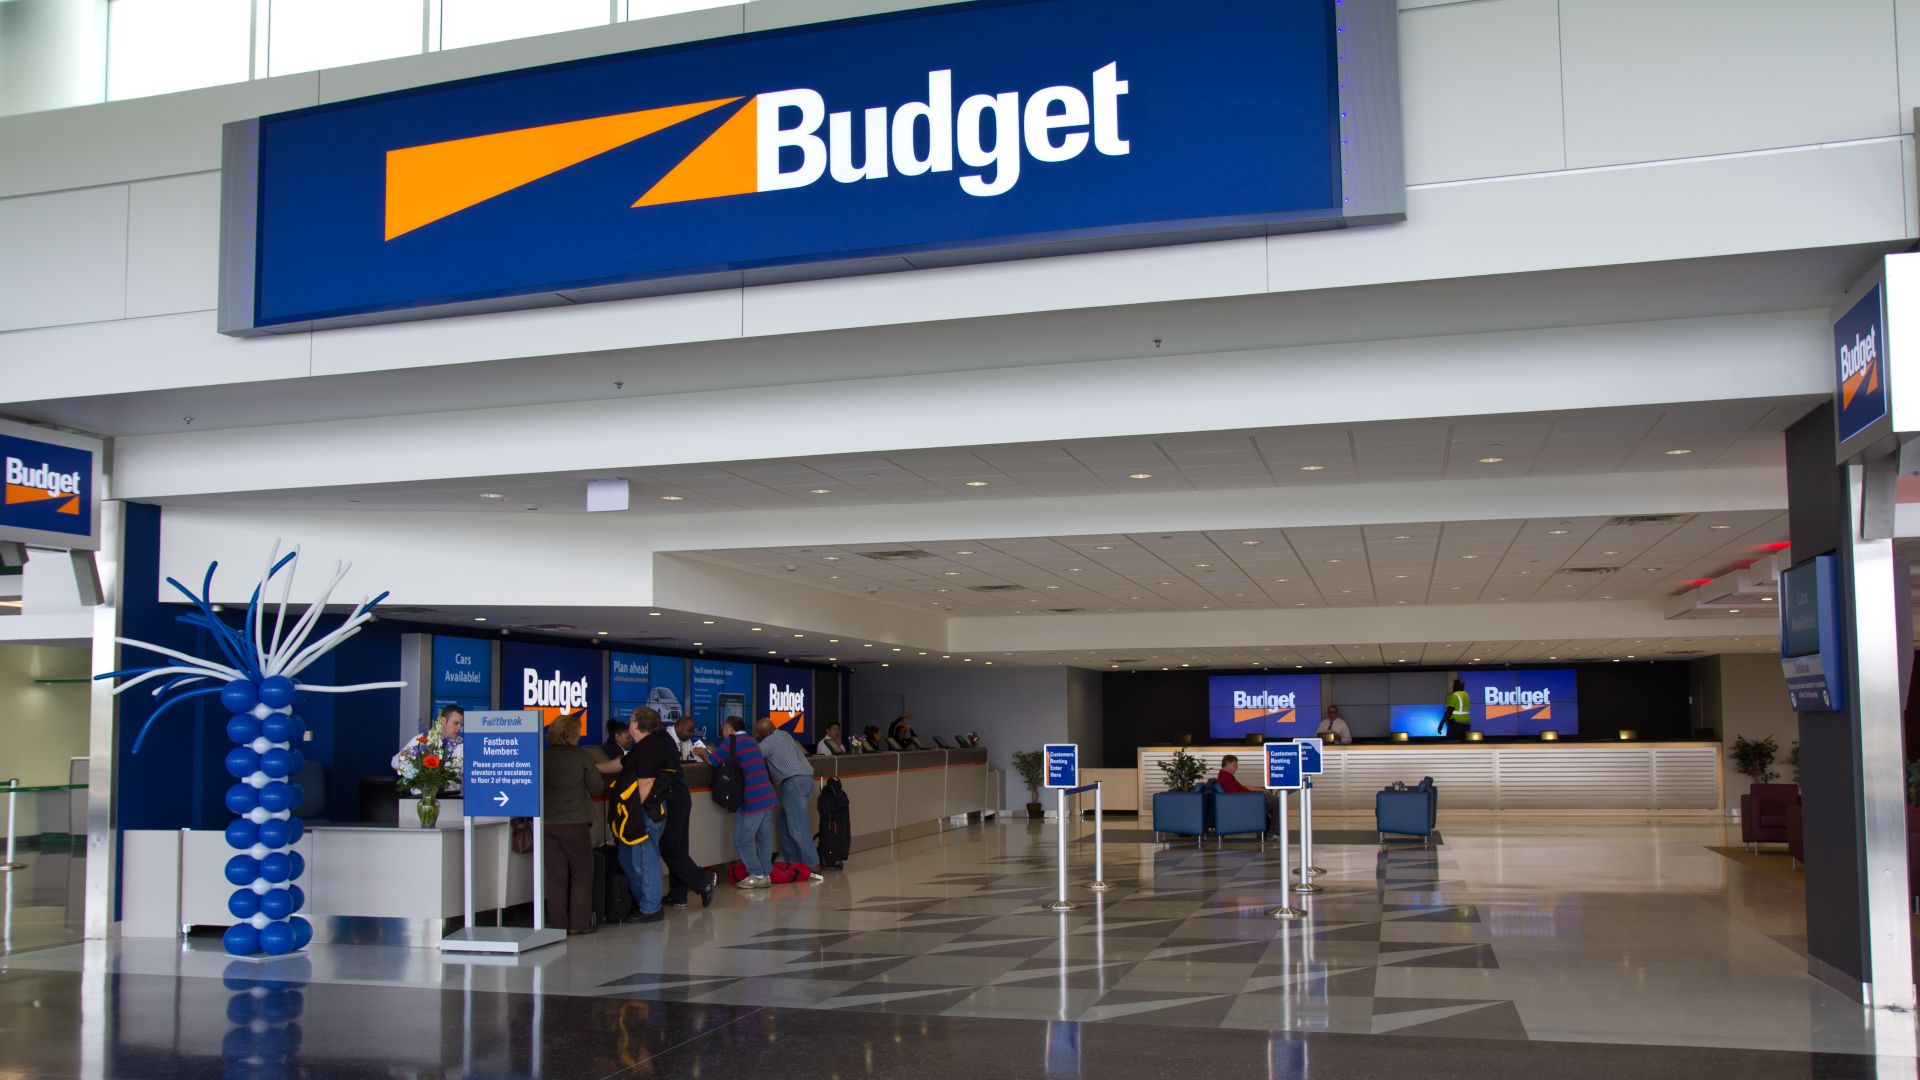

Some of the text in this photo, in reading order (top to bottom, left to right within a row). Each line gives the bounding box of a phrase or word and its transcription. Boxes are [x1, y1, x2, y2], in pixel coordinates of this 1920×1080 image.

[757, 60, 1130, 197] Budget
[1840, 324, 1877, 377] Budget
[6, 456, 80, 497] Budget
[455, 653, 472, 666] Cars
[613, 660, 649, 675] Plan ahead
[444, 670, 481, 683] Available!
[523, 667, 588, 716] Budget
[769, 683, 805, 719] Budget
[1484, 686, 1551, 710] Budget
[1233, 690, 1296, 713] Budget
[481, 716, 522, 726] Fastbreak
[484, 737, 519, 746] Fastbreak
[484, 747, 519, 756] Members:
[491, 761, 514, 769] proceed
